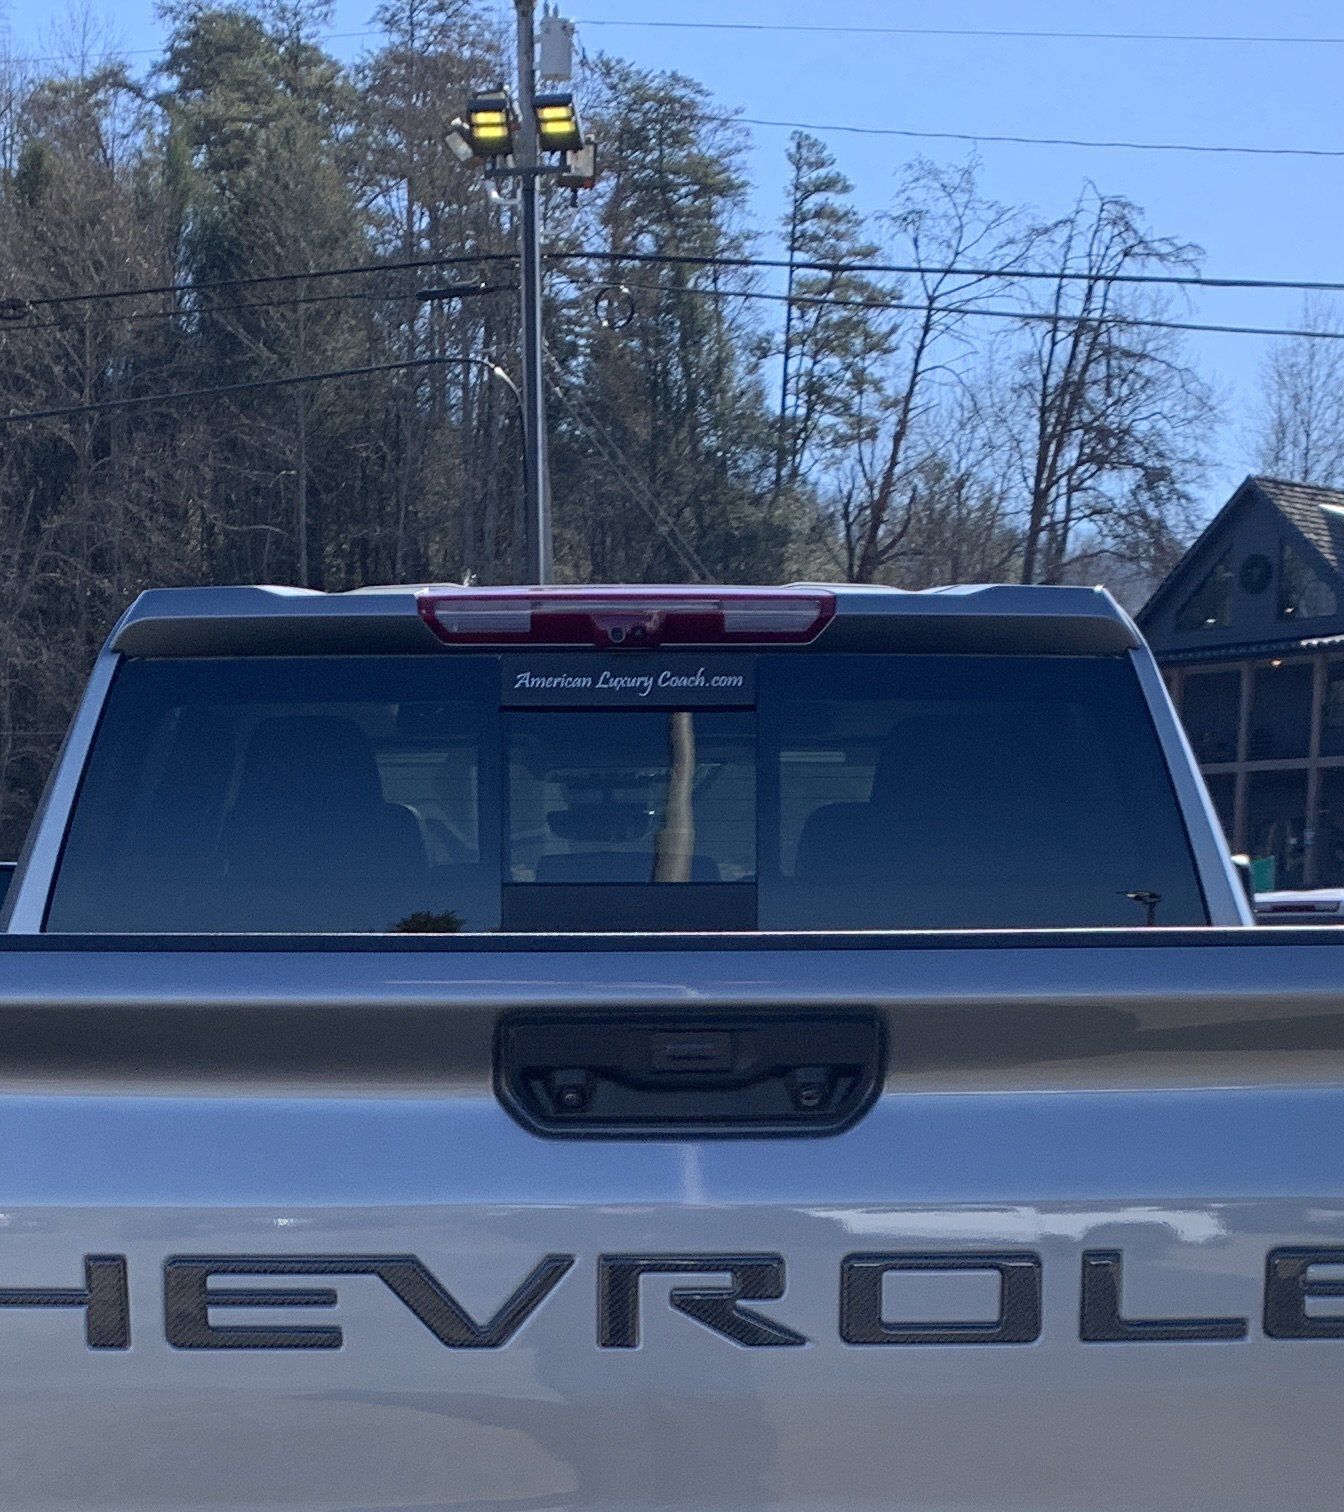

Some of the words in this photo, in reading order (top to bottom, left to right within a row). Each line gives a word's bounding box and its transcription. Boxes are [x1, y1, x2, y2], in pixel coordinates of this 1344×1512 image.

[514, 671, 592, 688] American
[595, 671, 654, 696] Luxury
[657, 667, 743, 688] Coach.com
